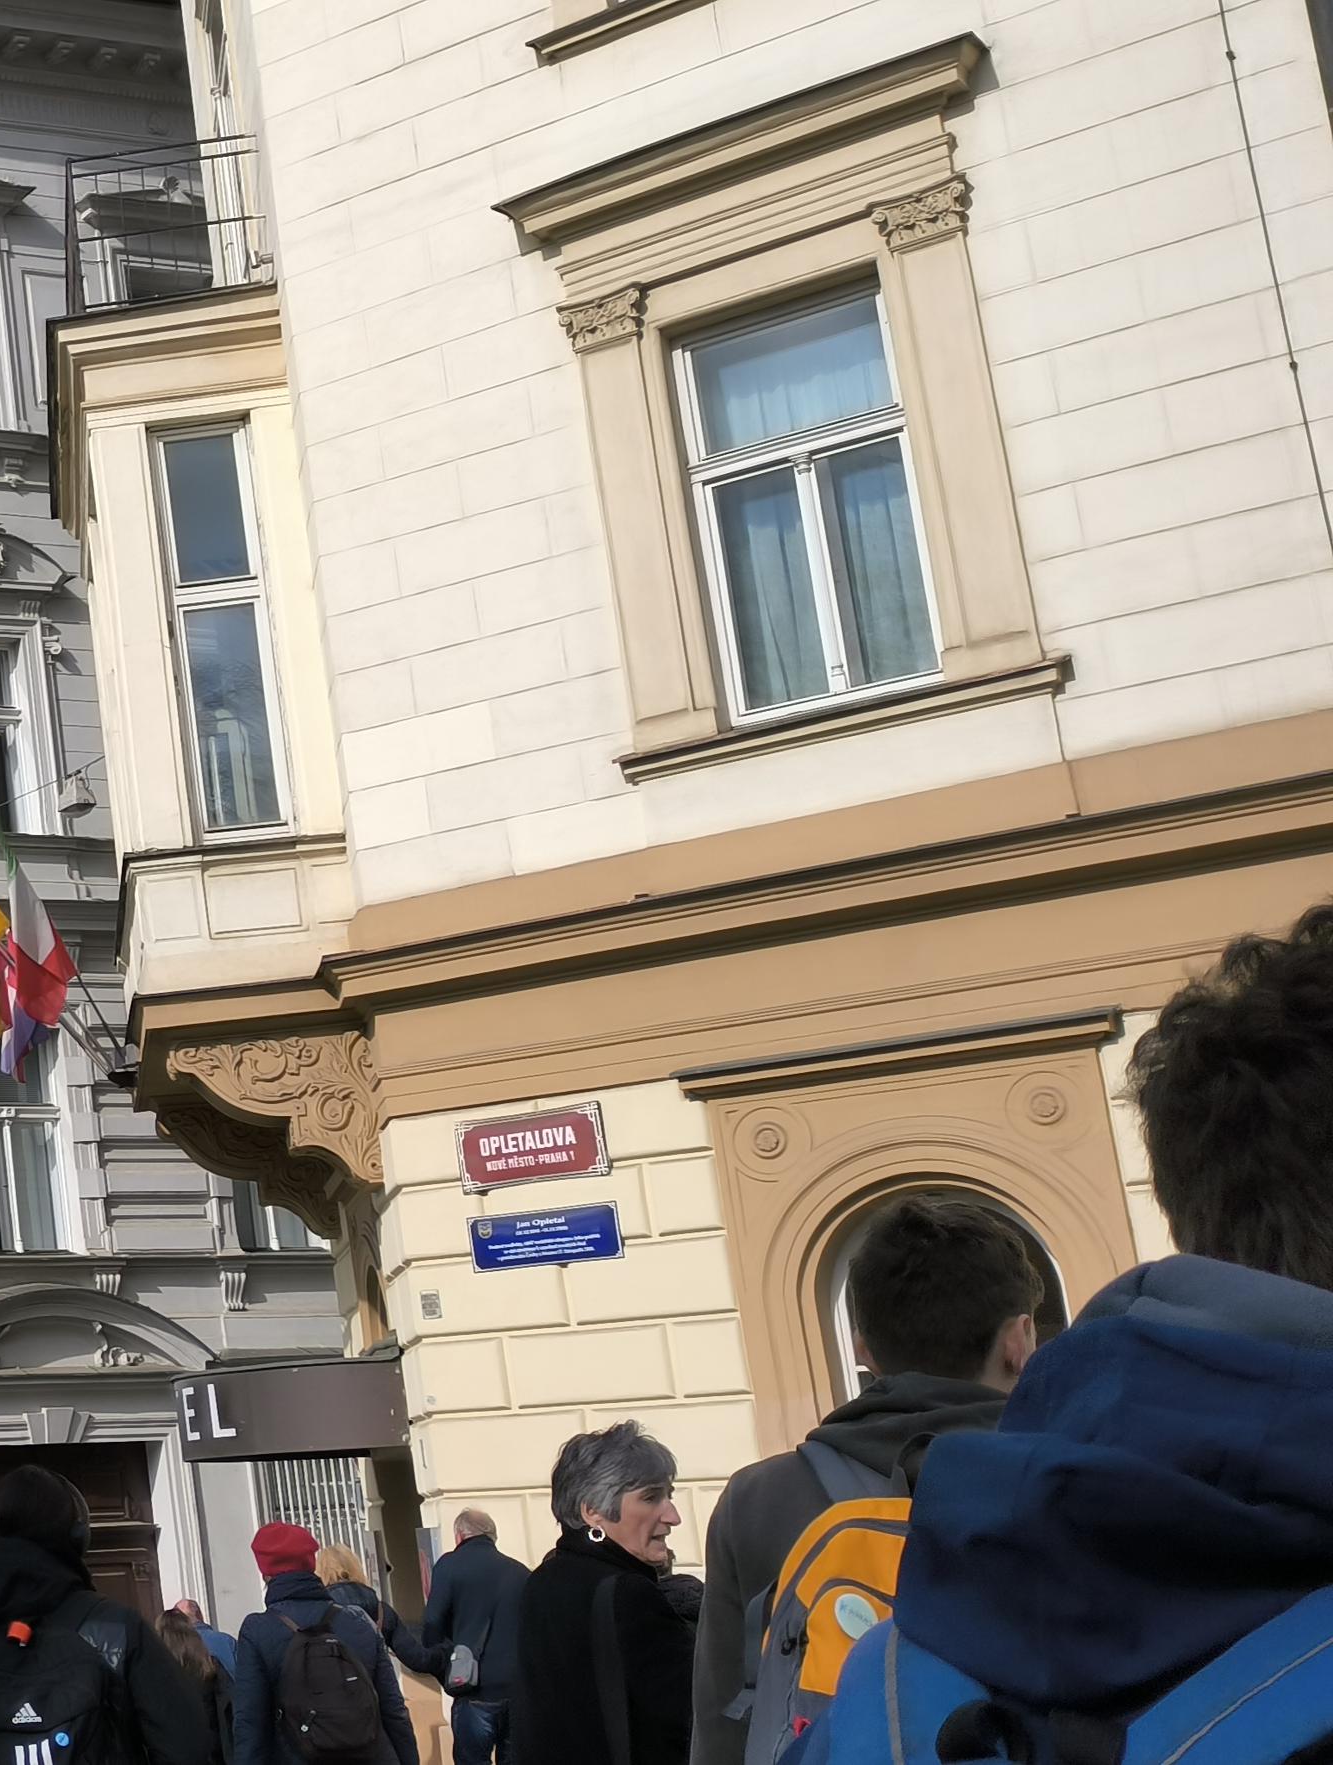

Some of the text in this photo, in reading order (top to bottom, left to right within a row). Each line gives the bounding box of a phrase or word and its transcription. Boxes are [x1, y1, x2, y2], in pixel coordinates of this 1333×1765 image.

[479, 1126, 577, 1156] OPLETALOVA
[486, 1158, 508, 1172] NOVÉ
[516, 1216, 565, 1229] Jan Opletal
[175, 1384, 237, 1441] EL
[12, 1715, 43, 1724] adidas
